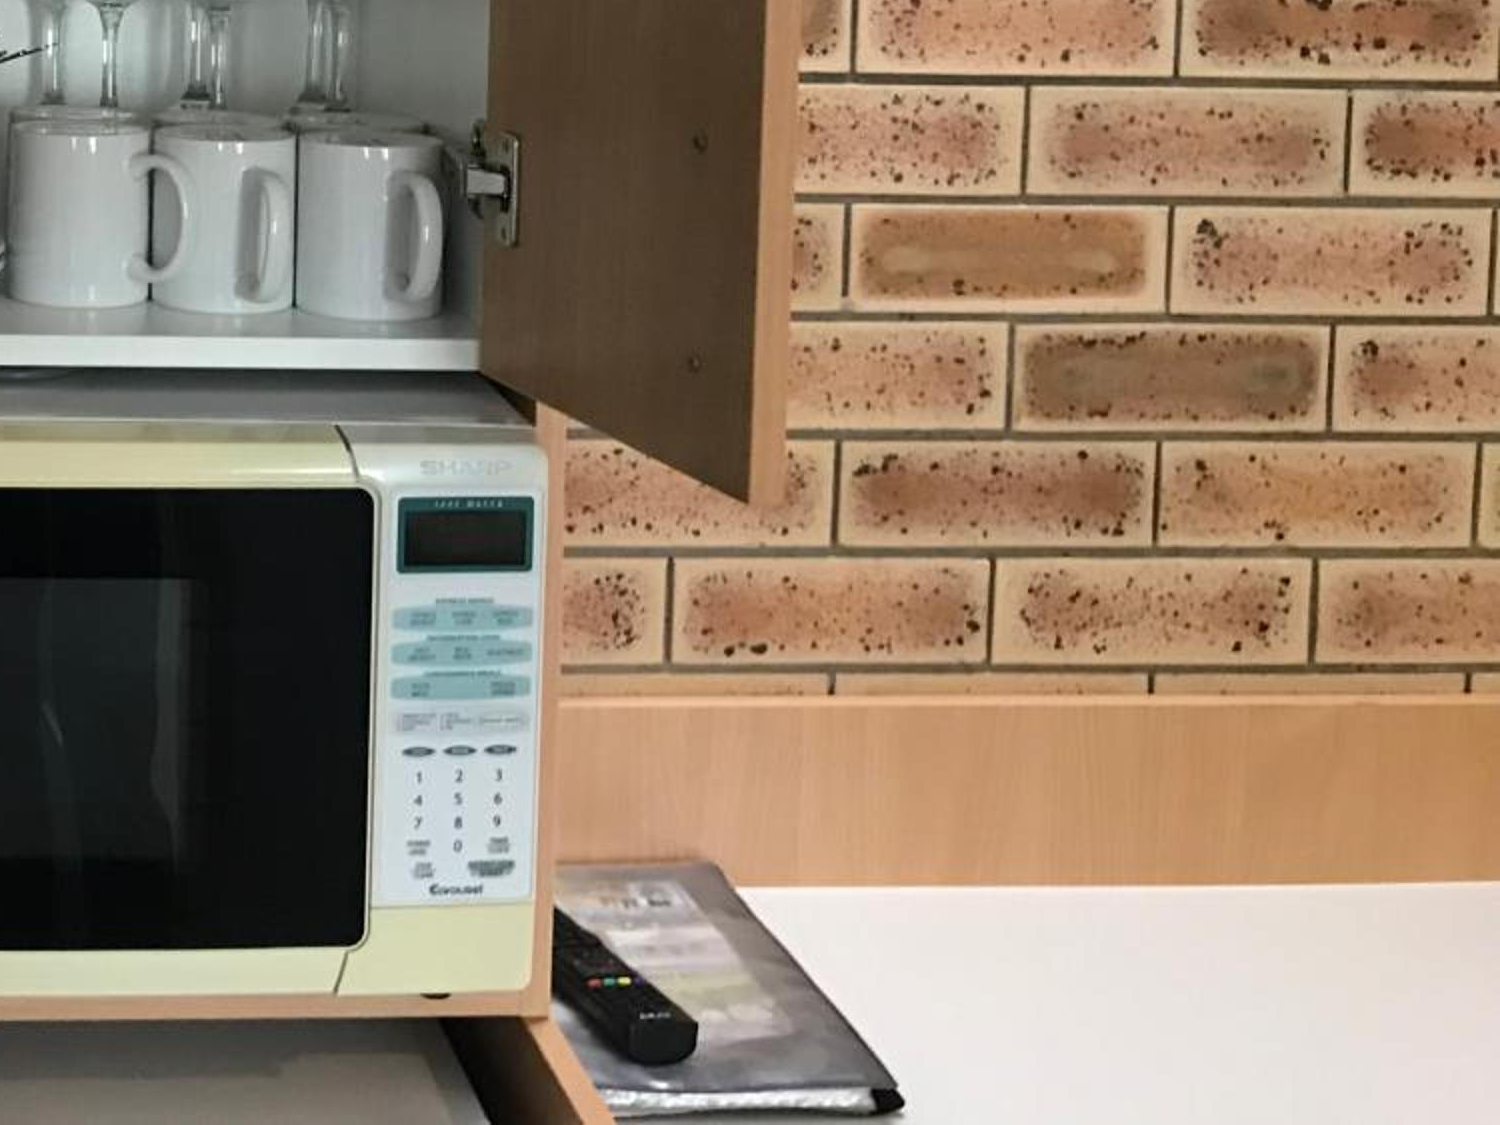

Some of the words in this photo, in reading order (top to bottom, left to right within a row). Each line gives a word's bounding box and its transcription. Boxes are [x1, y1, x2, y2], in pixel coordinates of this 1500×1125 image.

[420, 460, 514, 475] SHARP
[416, 771, 422, 784] 1
[454, 769, 463, 783] 2
[495, 769, 503, 782] 3
[414, 794, 423, 807] 4
[454, 793, 463, 805] 5
[494, 792, 502, 805] 6
[414, 816, 422, 830] 7
[454, 816, 463, 829] 8
[493, 815, 501, 828] 9
[454, 839, 462, 853] 0
